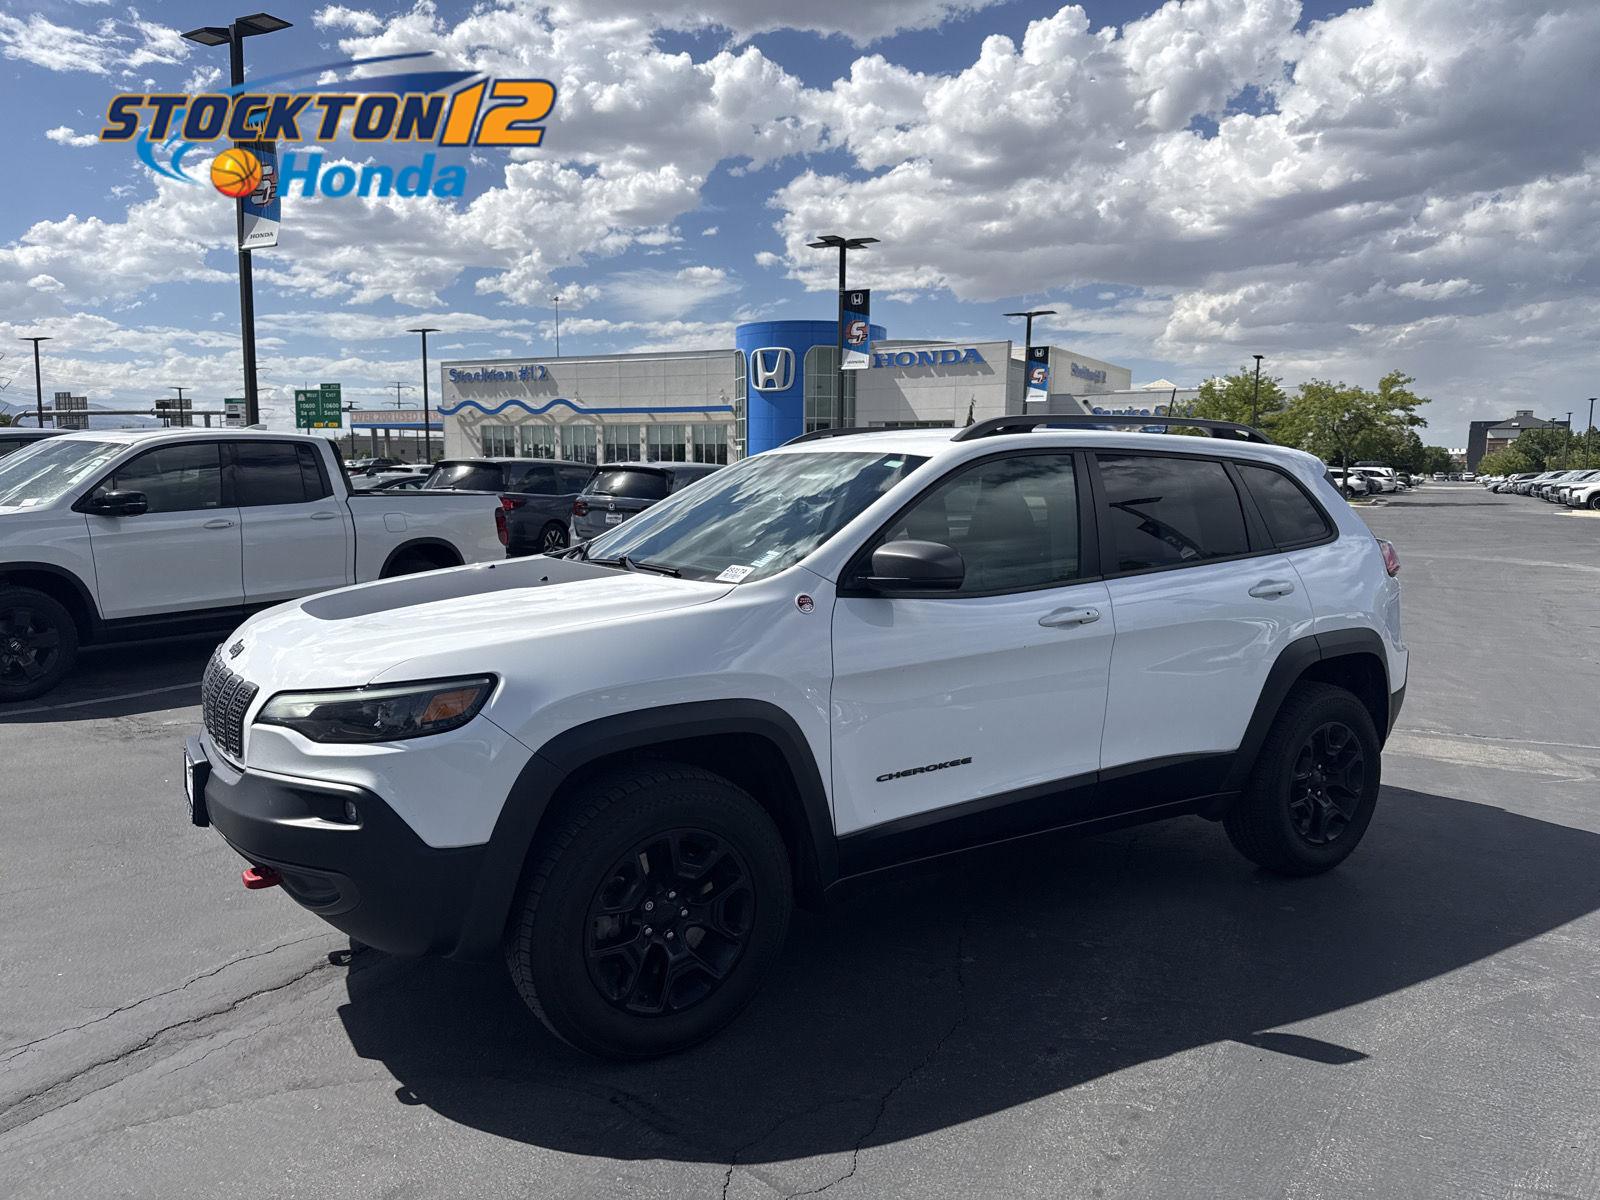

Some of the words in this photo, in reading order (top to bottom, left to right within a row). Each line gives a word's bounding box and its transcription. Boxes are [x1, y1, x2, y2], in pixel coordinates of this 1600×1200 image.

[249, 231, 274, 239] HONDA
[872, 348, 986, 369] HONDA
[876, 757, 972, 782] CHEROKEE
